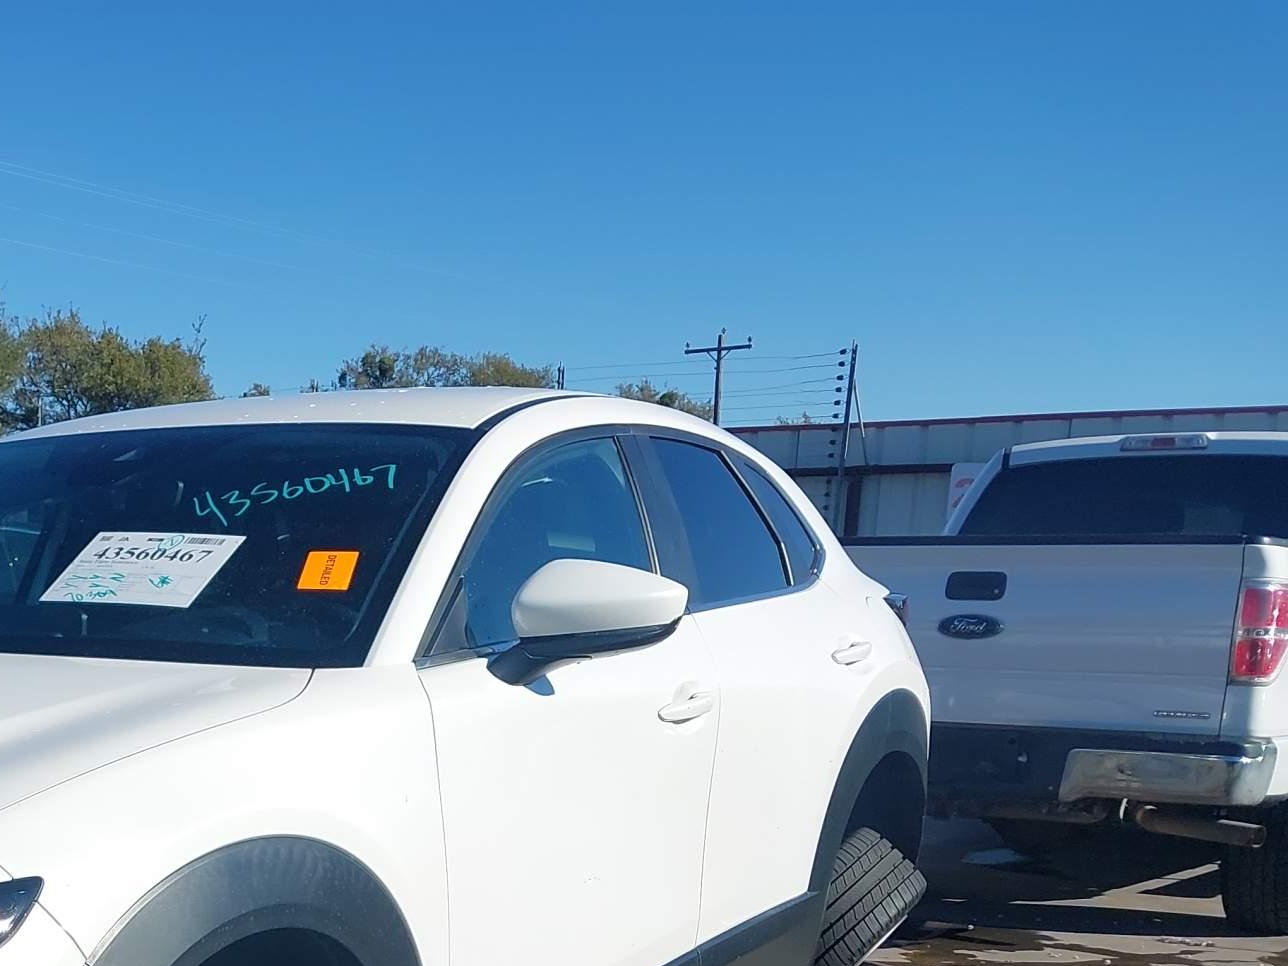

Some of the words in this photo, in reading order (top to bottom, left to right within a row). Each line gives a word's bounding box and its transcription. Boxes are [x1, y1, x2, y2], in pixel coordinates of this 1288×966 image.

[193, 464, 396, 527] 43560467
[93, 546, 214, 563] 43560467
[951, 617, 987, 633] Ford
